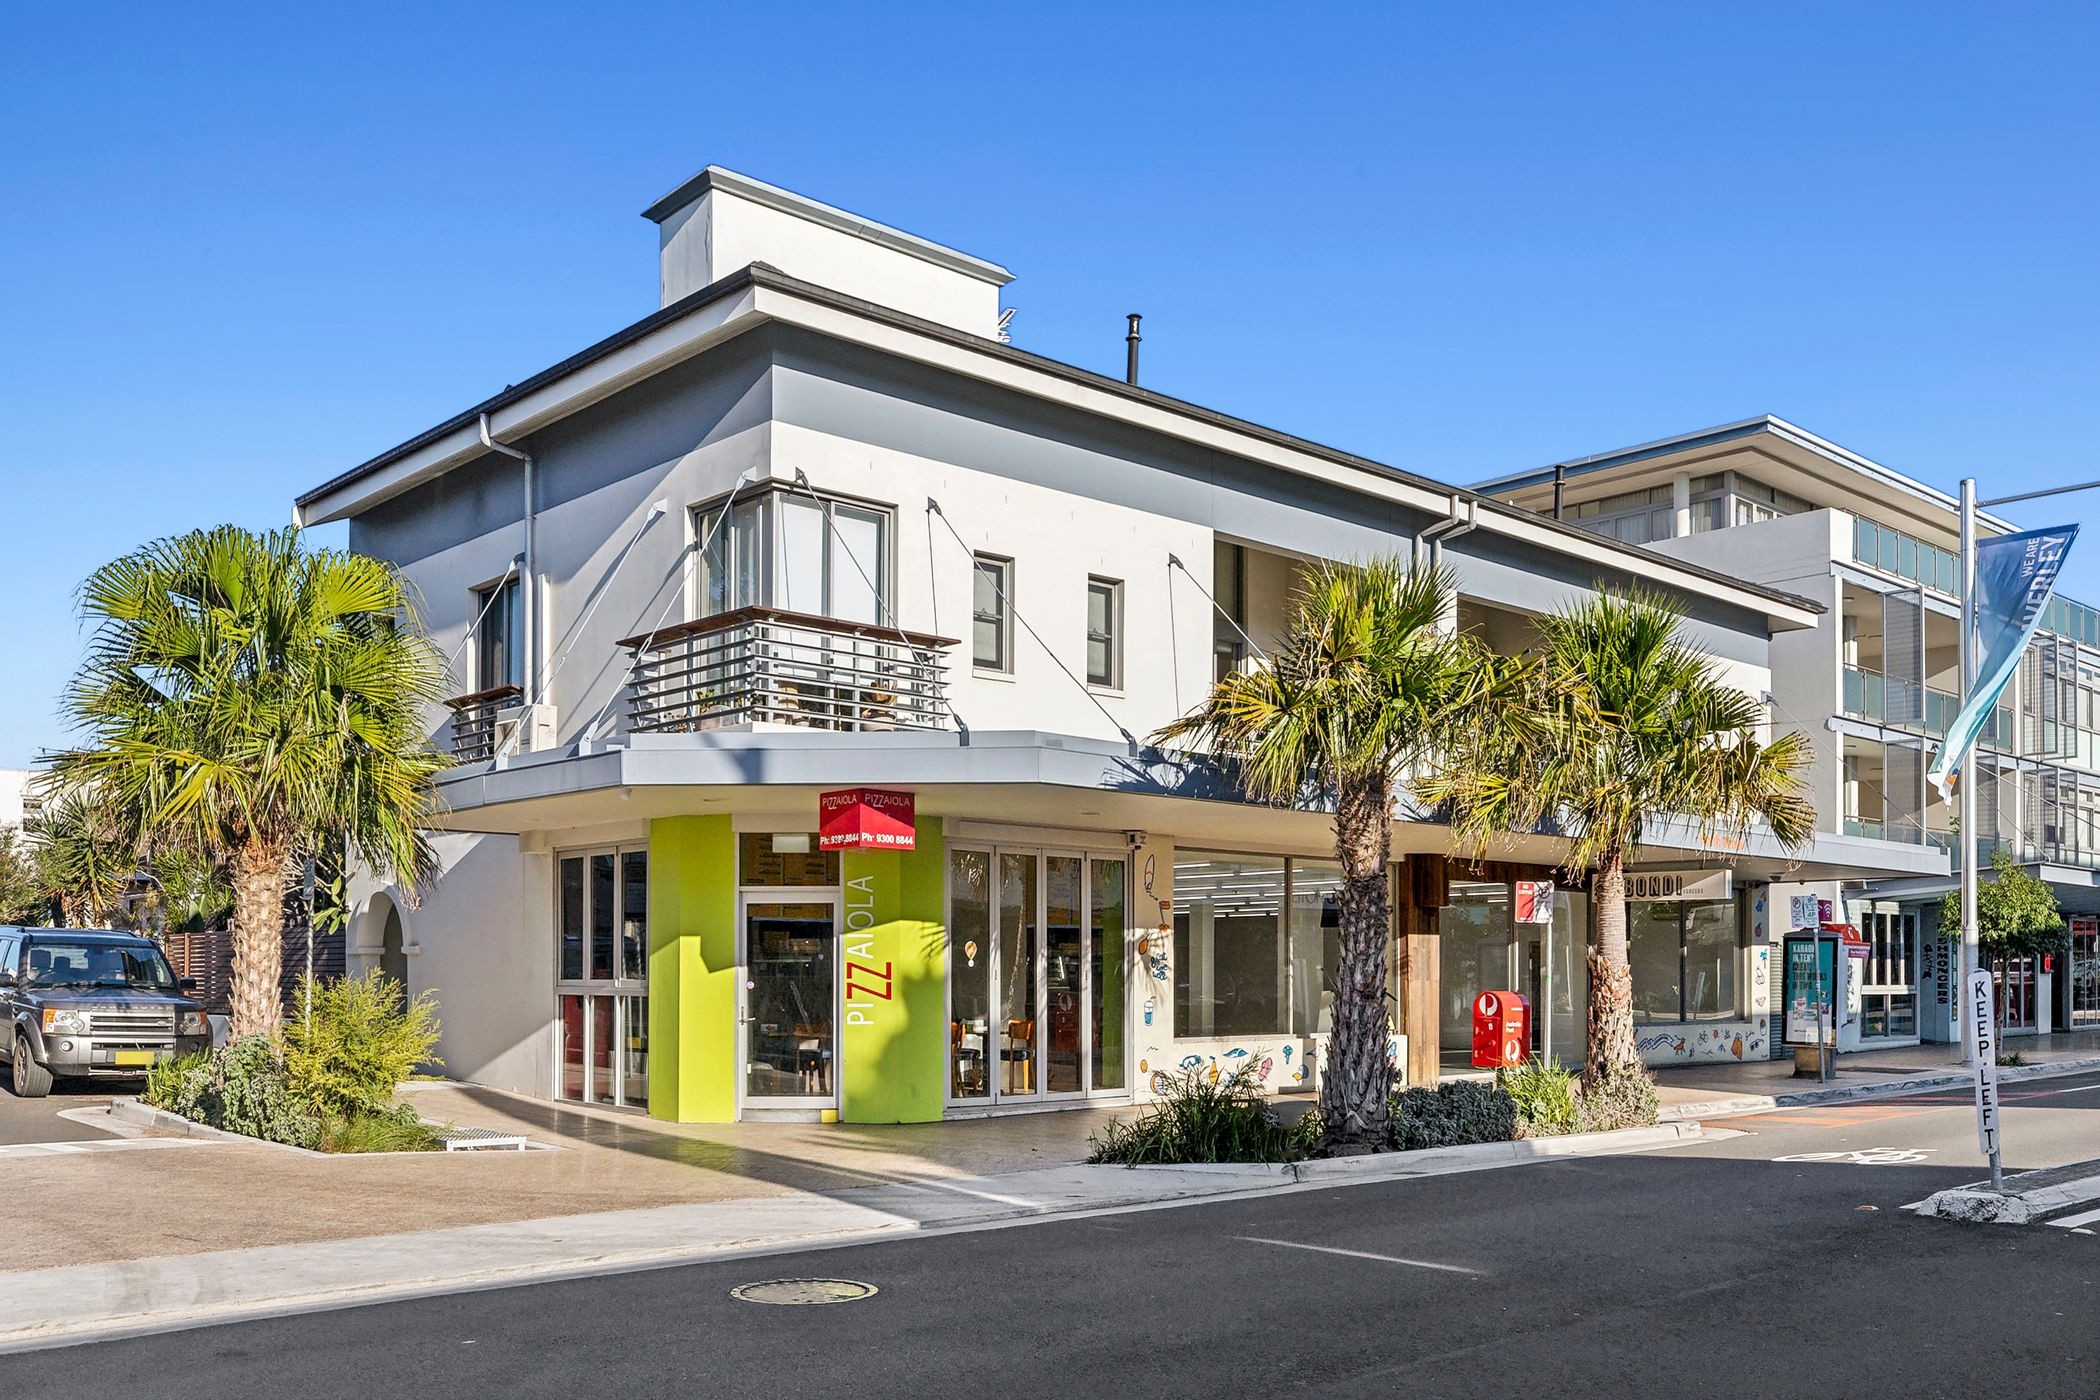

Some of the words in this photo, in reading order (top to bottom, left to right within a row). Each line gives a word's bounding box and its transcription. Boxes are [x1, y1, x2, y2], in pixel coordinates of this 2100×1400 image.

[2026, 538, 2040, 558] ARE
[2021, 559, 2035, 578] WE
[2021, 537, 2065, 631] VERLEY
[822, 794, 857, 810] PIZZAIOLA
[865, 793, 910, 808] PIZZAIOLA
[820, 836, 830, 845] Ph:
[845, 833, 859, 843] 8844
[876, 834, 894, 844] 9300
[895, 835, 913, 845] 8844
[1624, 875, 1683, 897] BONDI
[846, 875, 892, 1025] PIZZAIOLA
[1936, 937, 1949, 1005] SHMONGERS
[1974, 981, 1990, 1058] KEEP
[1980, 1069, 1994, 1149] LEFT
